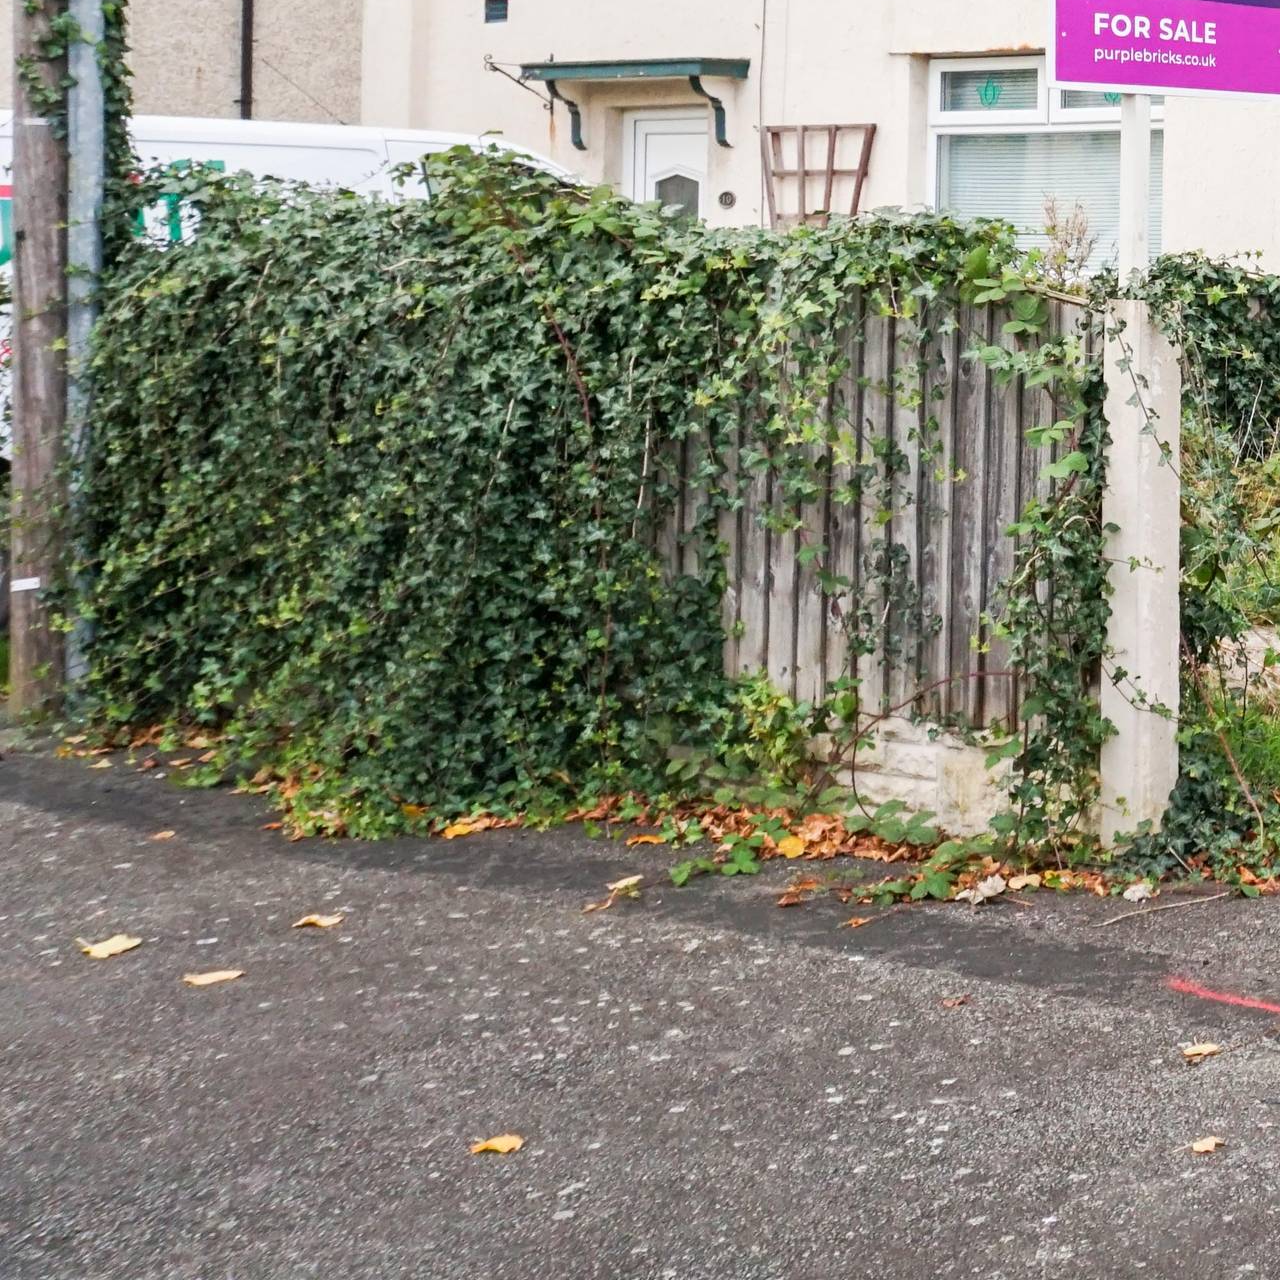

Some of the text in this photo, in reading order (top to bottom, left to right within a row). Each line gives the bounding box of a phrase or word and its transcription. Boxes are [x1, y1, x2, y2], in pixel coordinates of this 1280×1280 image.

[1094, 13, 1217, 45] FOR SALE
[1094, 47, 1216, 68] purplebricks.co.uk
